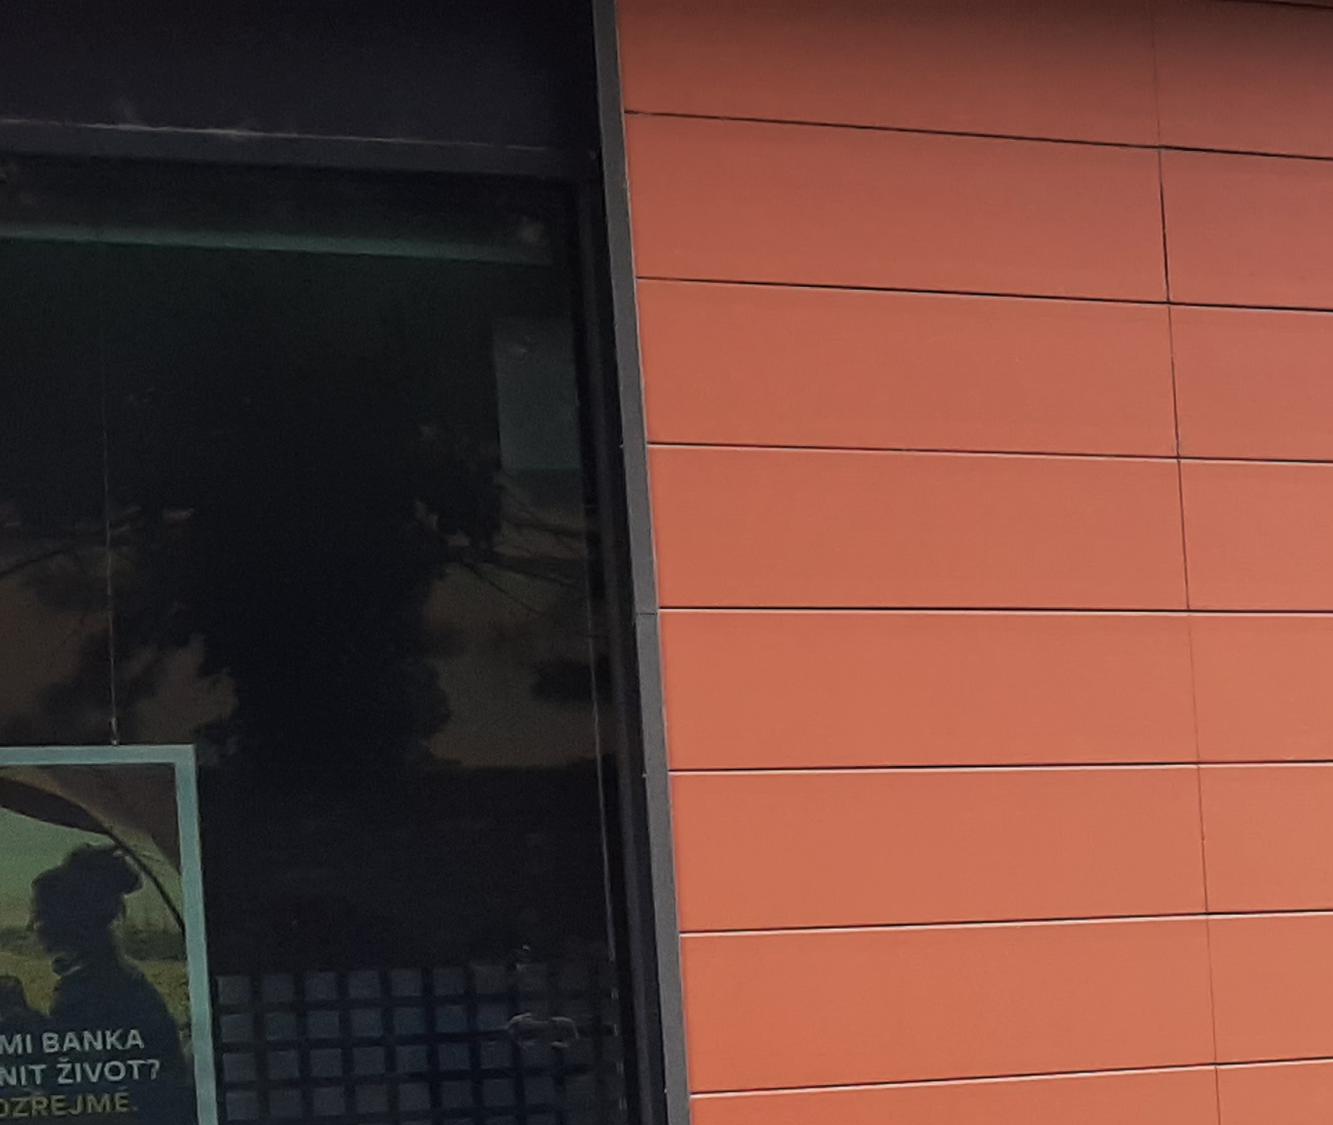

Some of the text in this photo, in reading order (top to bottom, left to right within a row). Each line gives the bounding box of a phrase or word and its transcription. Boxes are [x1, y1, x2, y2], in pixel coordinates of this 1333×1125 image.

[42, 1029, 145, 1053] BANKA
[0, 1057, 161, 1087] NIT ŽIVOT?
